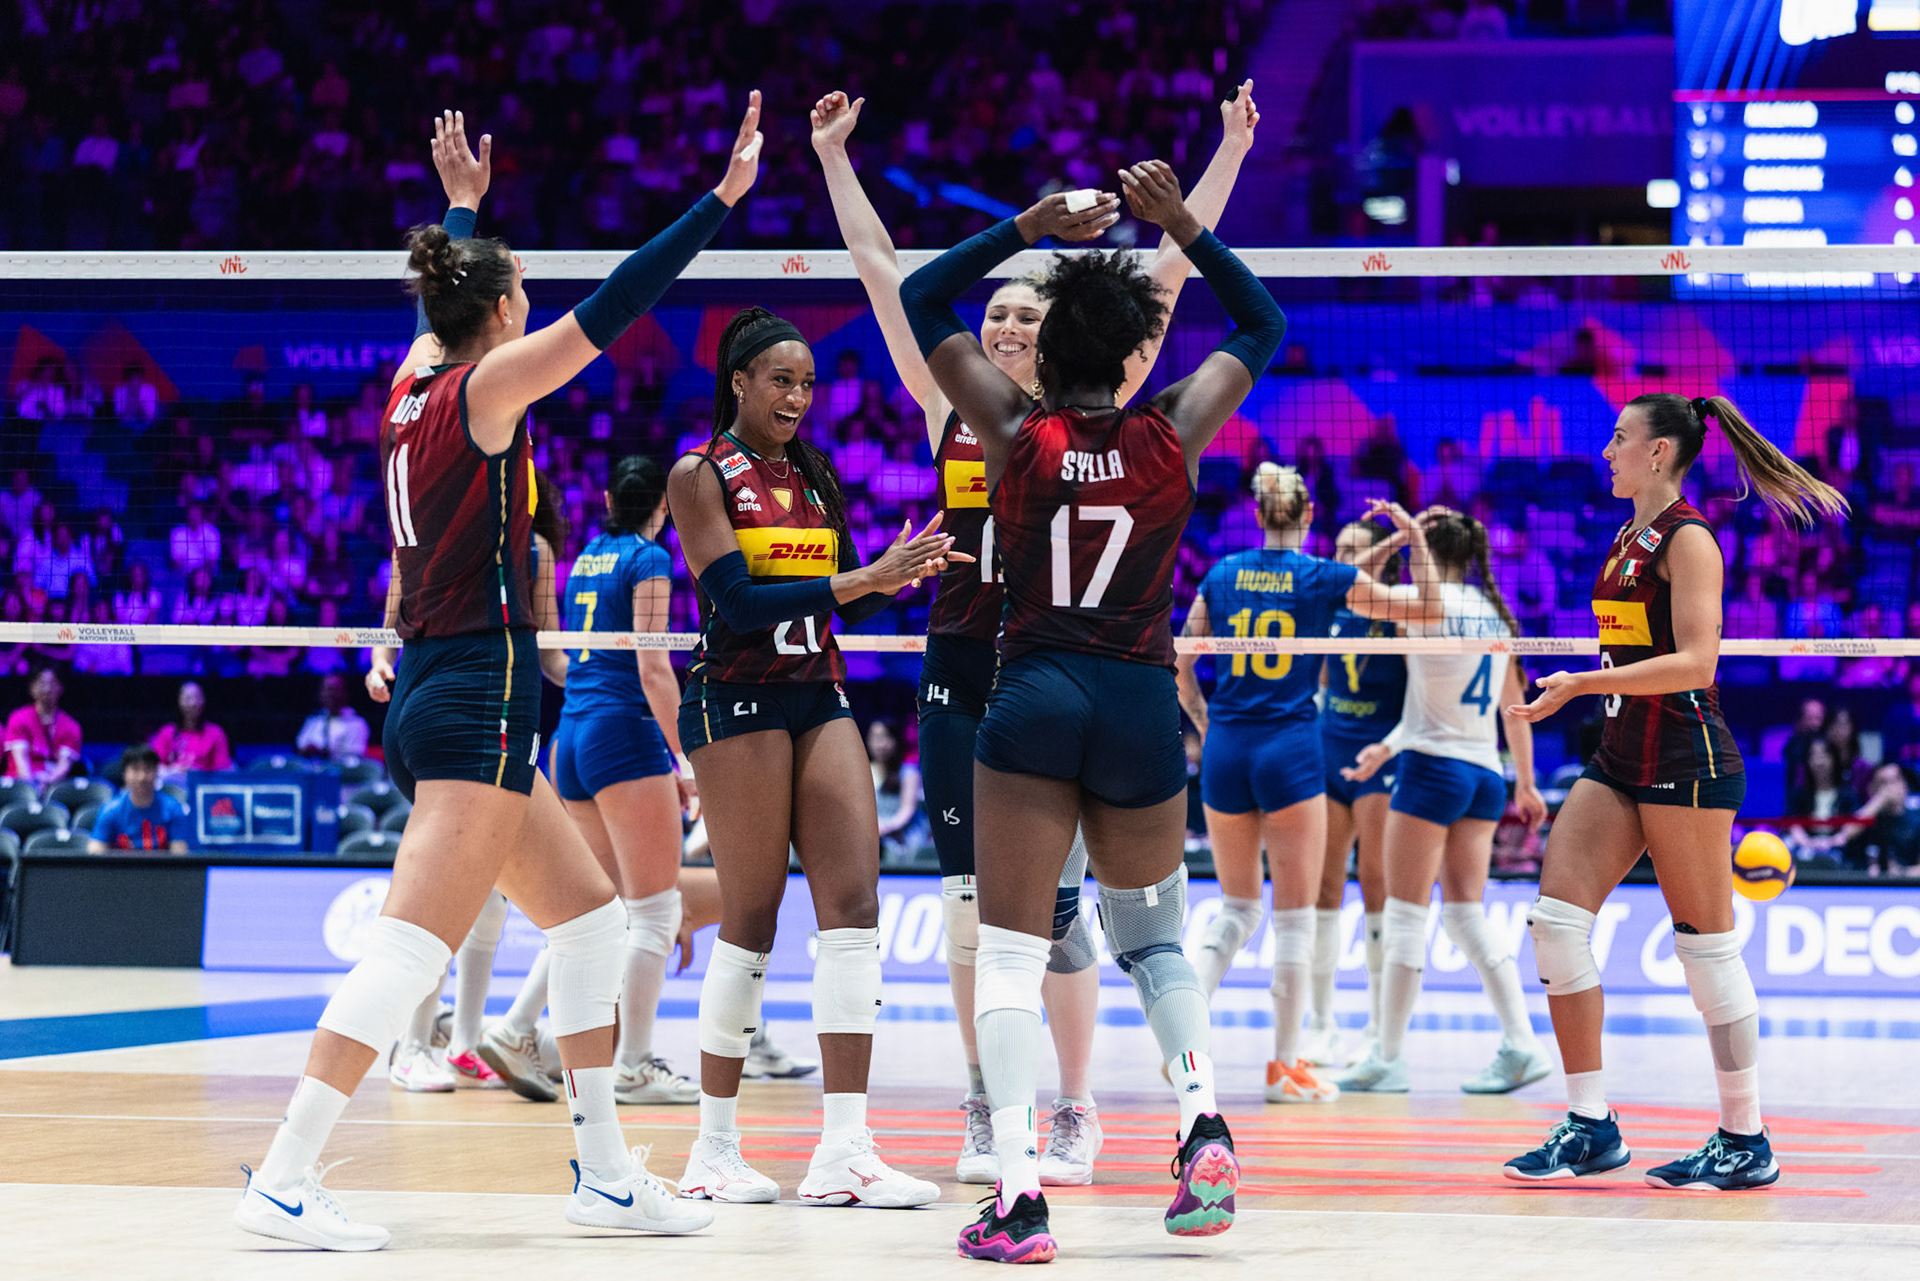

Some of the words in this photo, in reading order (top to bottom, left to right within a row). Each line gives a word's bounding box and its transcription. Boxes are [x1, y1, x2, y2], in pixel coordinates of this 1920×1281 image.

[220, 255, 248, 274] VNL
[781, 254, 810, 274] VNL
[1362, 252, 1392, 272] VNL
[1660, 250, 1691, 270] VNL
[1061, 449, 1126, 483] SYLLA
[387, 443, 417, 547] 11
[768, 543, 830, 560] DHL
[1050, 504, 1135, 608] 17
[1617, 575, 1638, 588] ITA
[79, 628, 134, 636] VOLLEYBALL
[575, 590, 598, 663] 7
[1228, 607, 1297, 681] 10
[926, 683, 950, 706] 14
[1460, 653, 1493, 717] 4
